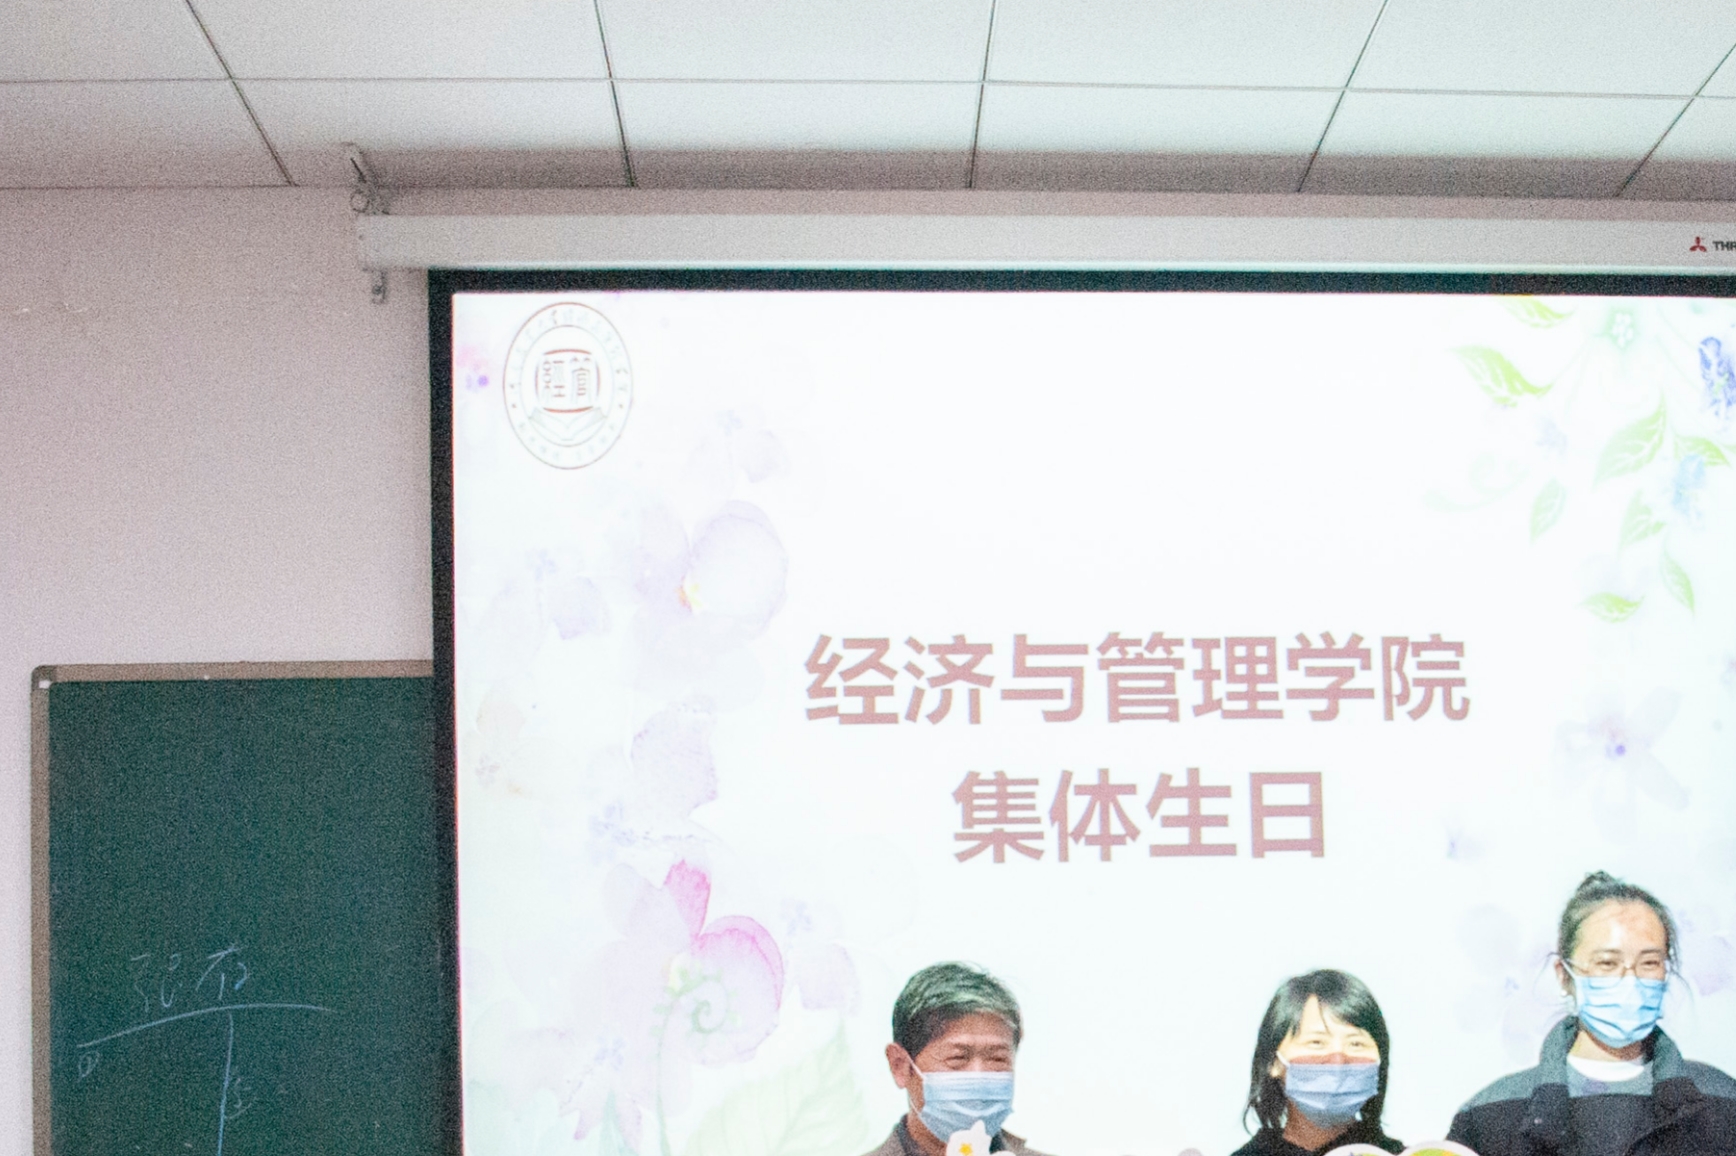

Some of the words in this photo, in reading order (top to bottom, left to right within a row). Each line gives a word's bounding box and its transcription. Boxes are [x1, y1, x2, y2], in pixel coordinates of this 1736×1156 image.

[804, 632, 1470, 725] 经济与管理学院
[951, 767, 1326, 864] 集体生日
